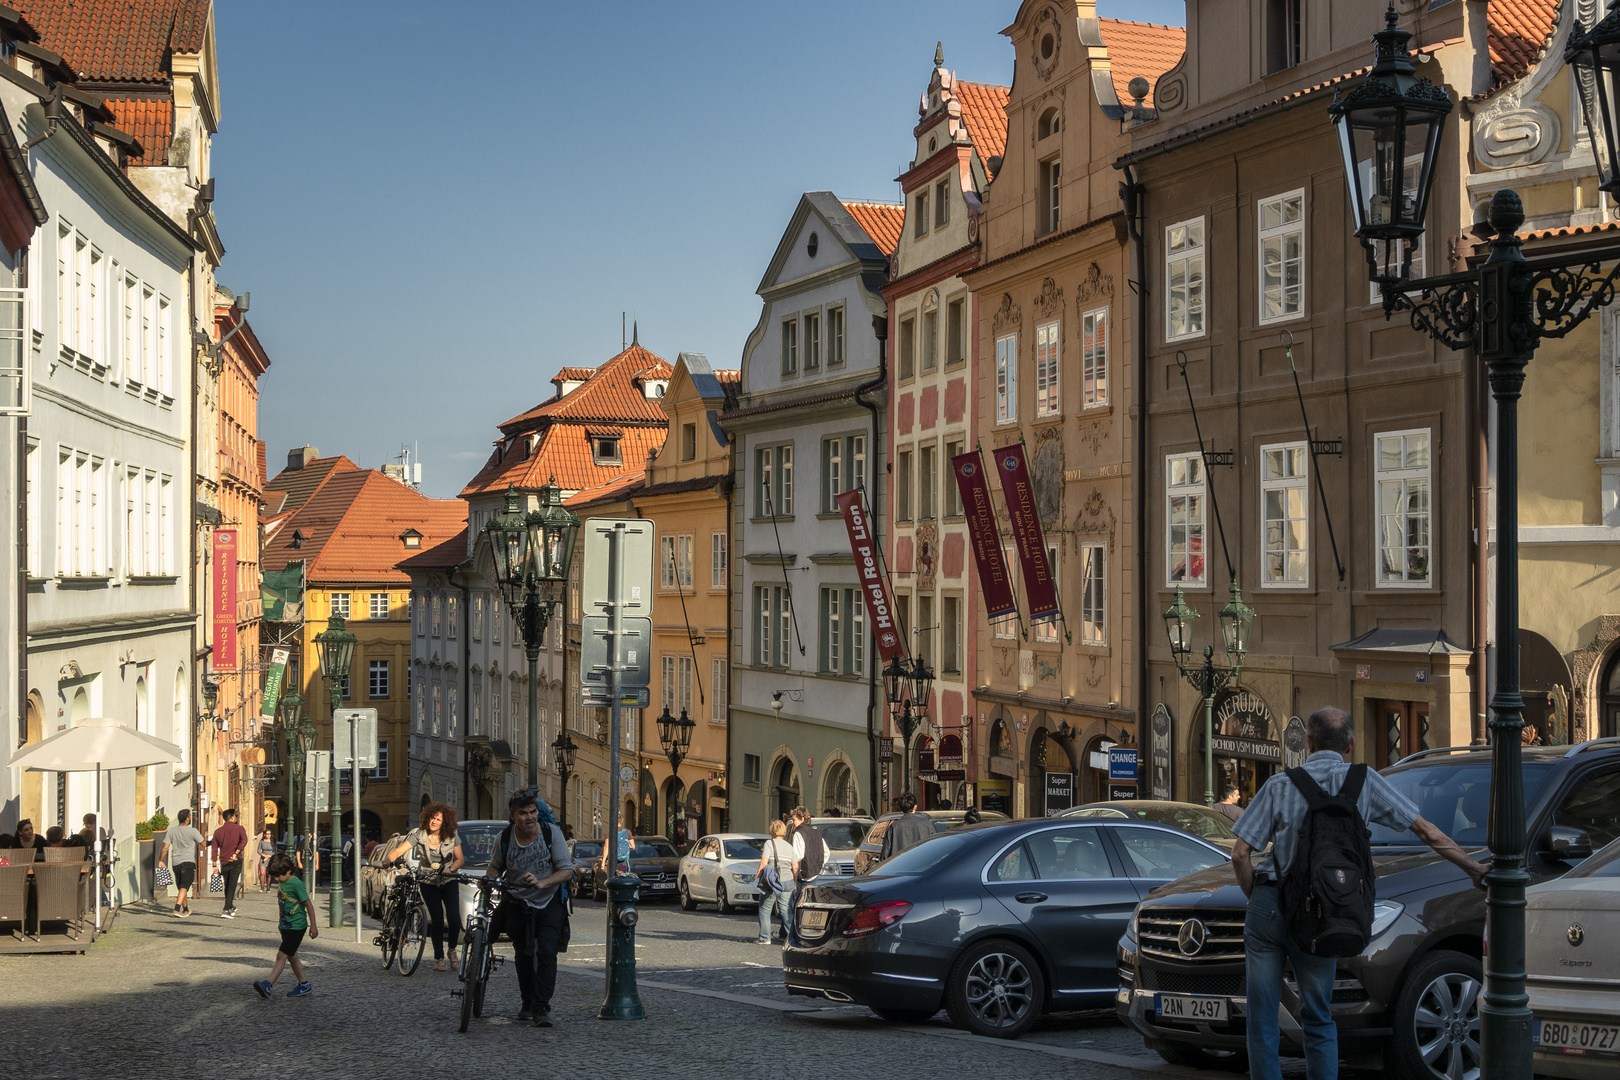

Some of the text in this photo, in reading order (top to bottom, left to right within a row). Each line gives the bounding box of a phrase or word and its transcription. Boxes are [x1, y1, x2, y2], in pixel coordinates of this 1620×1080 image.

[973, 487, 1003, 585] RESIDENCE HOTEL
[1016, 482, 1047, 584] RESIDENCE HOTEL
[977, 540, 986, 560] PRAGUE
[1022, 536, 1030, 559] PRAGUE
[850, 505, 891, 628] Hotel Red Lion
[1416, 671, 1425, 679] 45
[264, 676, 274, 700] VEGAN
[269, 672, 281, 708] RESTAURANT
[1217, 693, 1272, 725] NERUDOV
[1110, 753, 1137, 763] CHANGE
[1051, 776, 1067, 786] Super
[1047, 788, 1070, 796] MARKET
[1113, 790, 1134, 798] Super
[1560, 958, 1592, 967] Superb
[1164, 998, 1220, 1017] 2AN 2497
[1543, 1024, 1618, 1048] 6B0 0727
